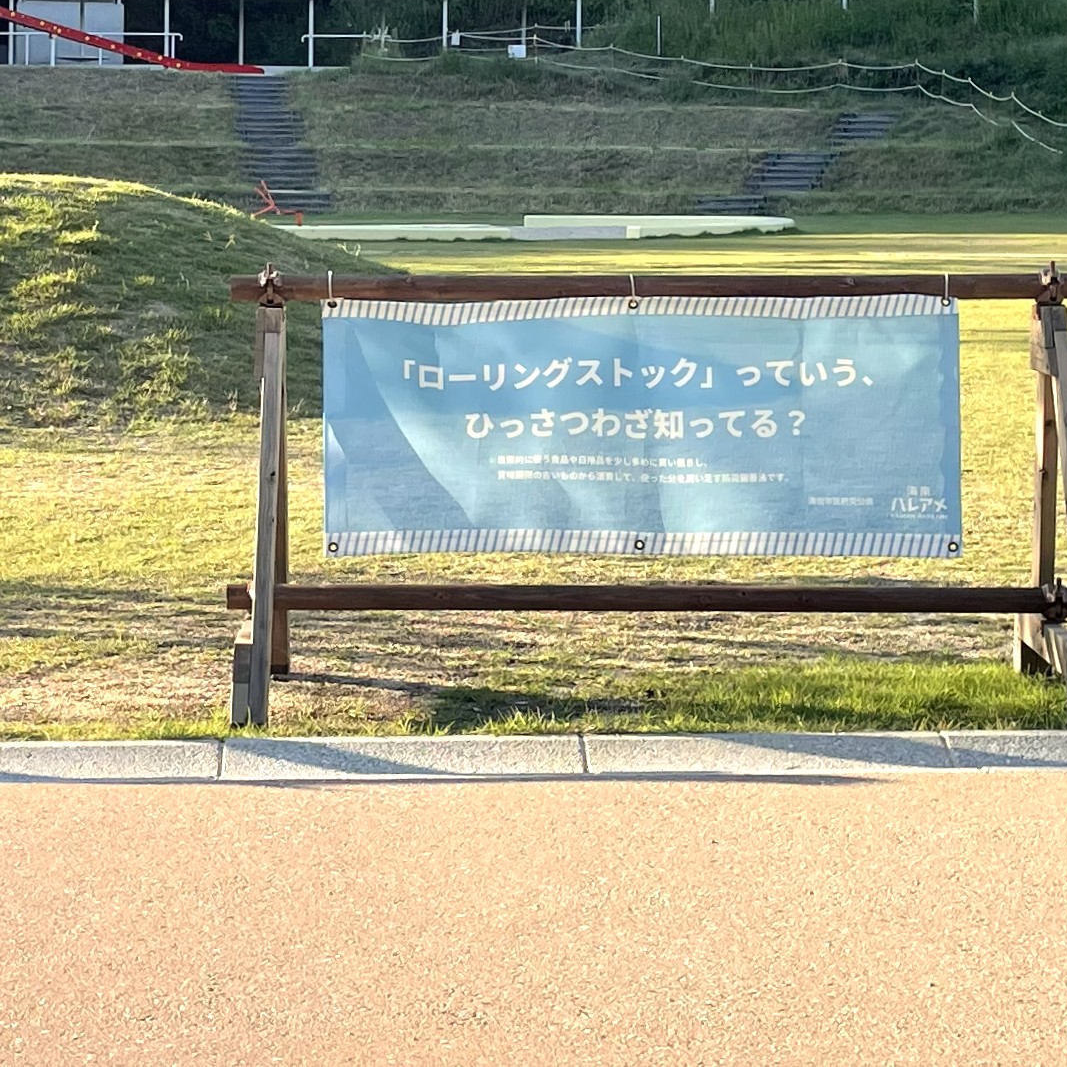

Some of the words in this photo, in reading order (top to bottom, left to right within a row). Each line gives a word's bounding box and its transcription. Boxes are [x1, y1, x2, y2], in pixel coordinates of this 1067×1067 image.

[403, 357, 874, 391] 「ローリングストック」っていう、
[465, 408, 806, 439] ひっさつわざ知ってる？
[890, 497, 948, 512] ハレアメ
